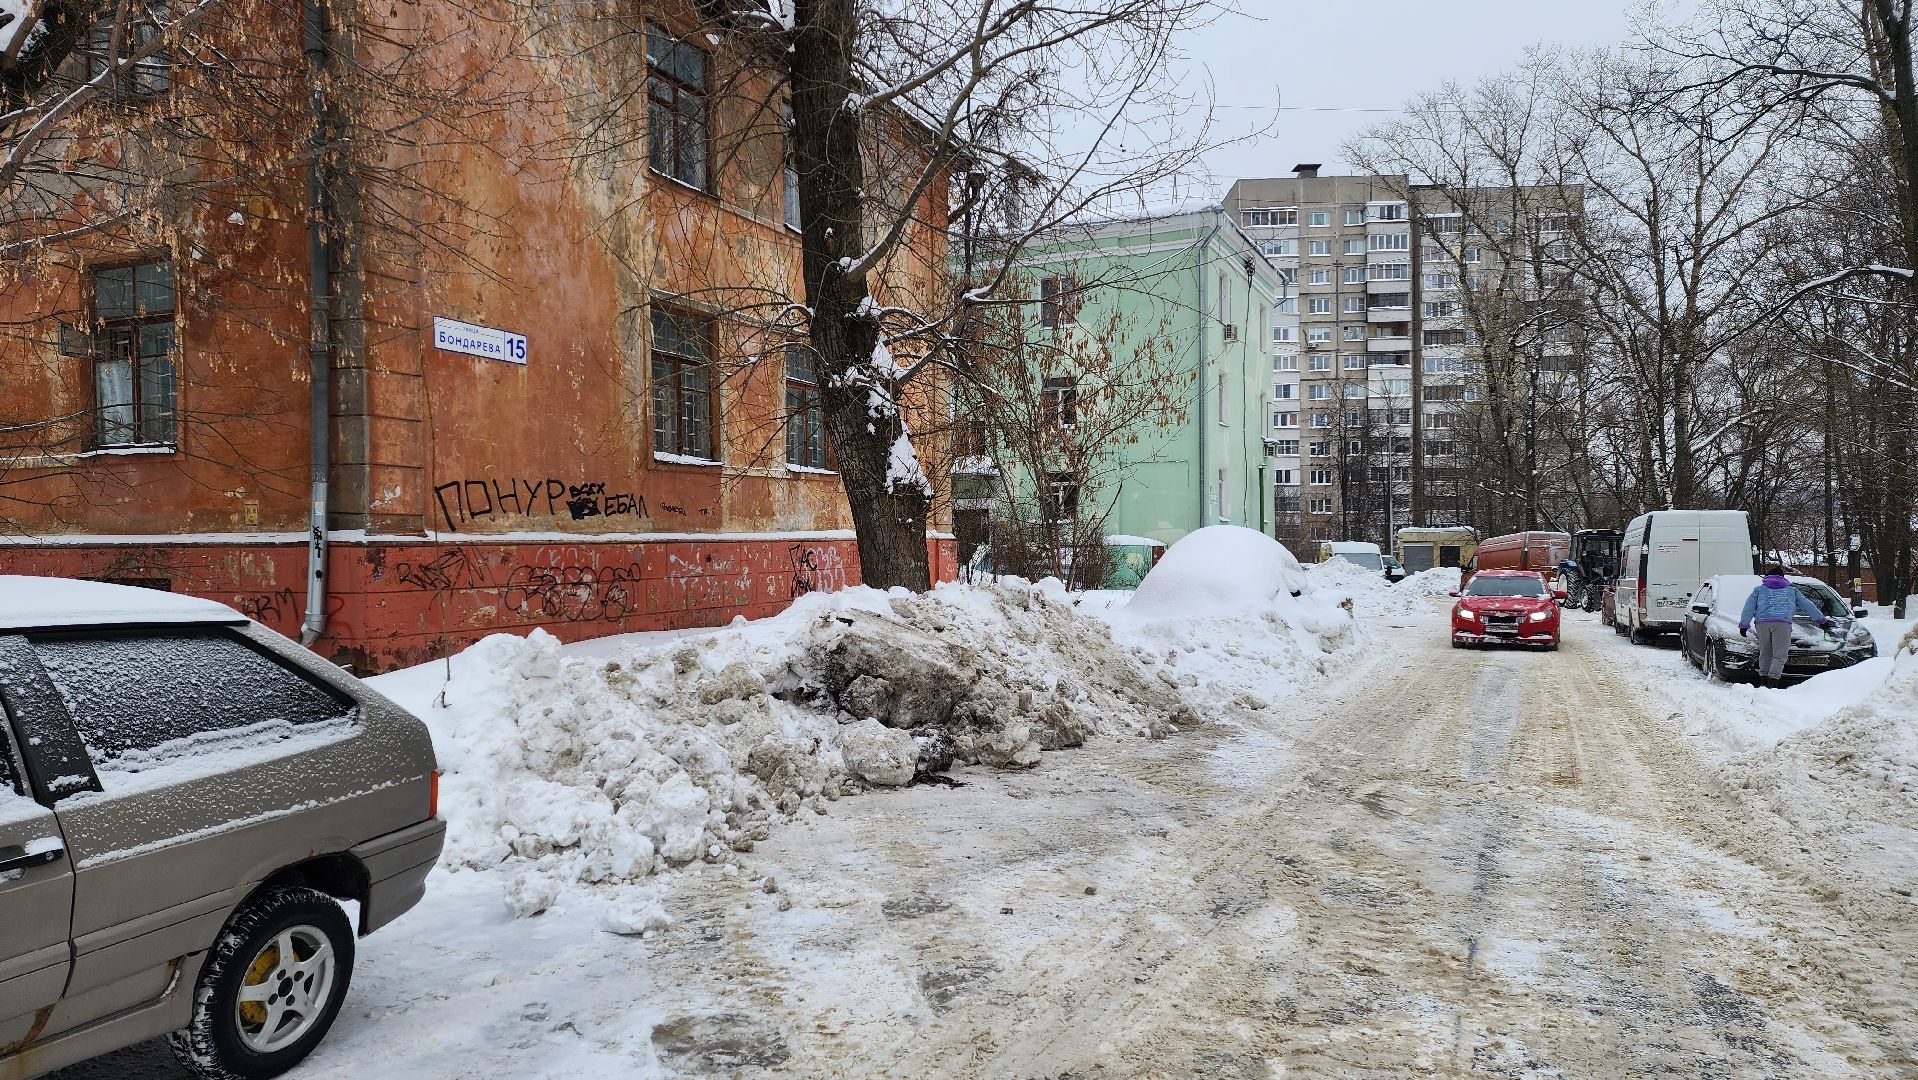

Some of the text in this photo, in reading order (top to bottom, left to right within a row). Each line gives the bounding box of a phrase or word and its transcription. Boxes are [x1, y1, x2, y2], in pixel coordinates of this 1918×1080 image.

[439, 331, 526, 360] БОНДАРЕВА 15
[432, 477, 566, 532] ПОНУР
